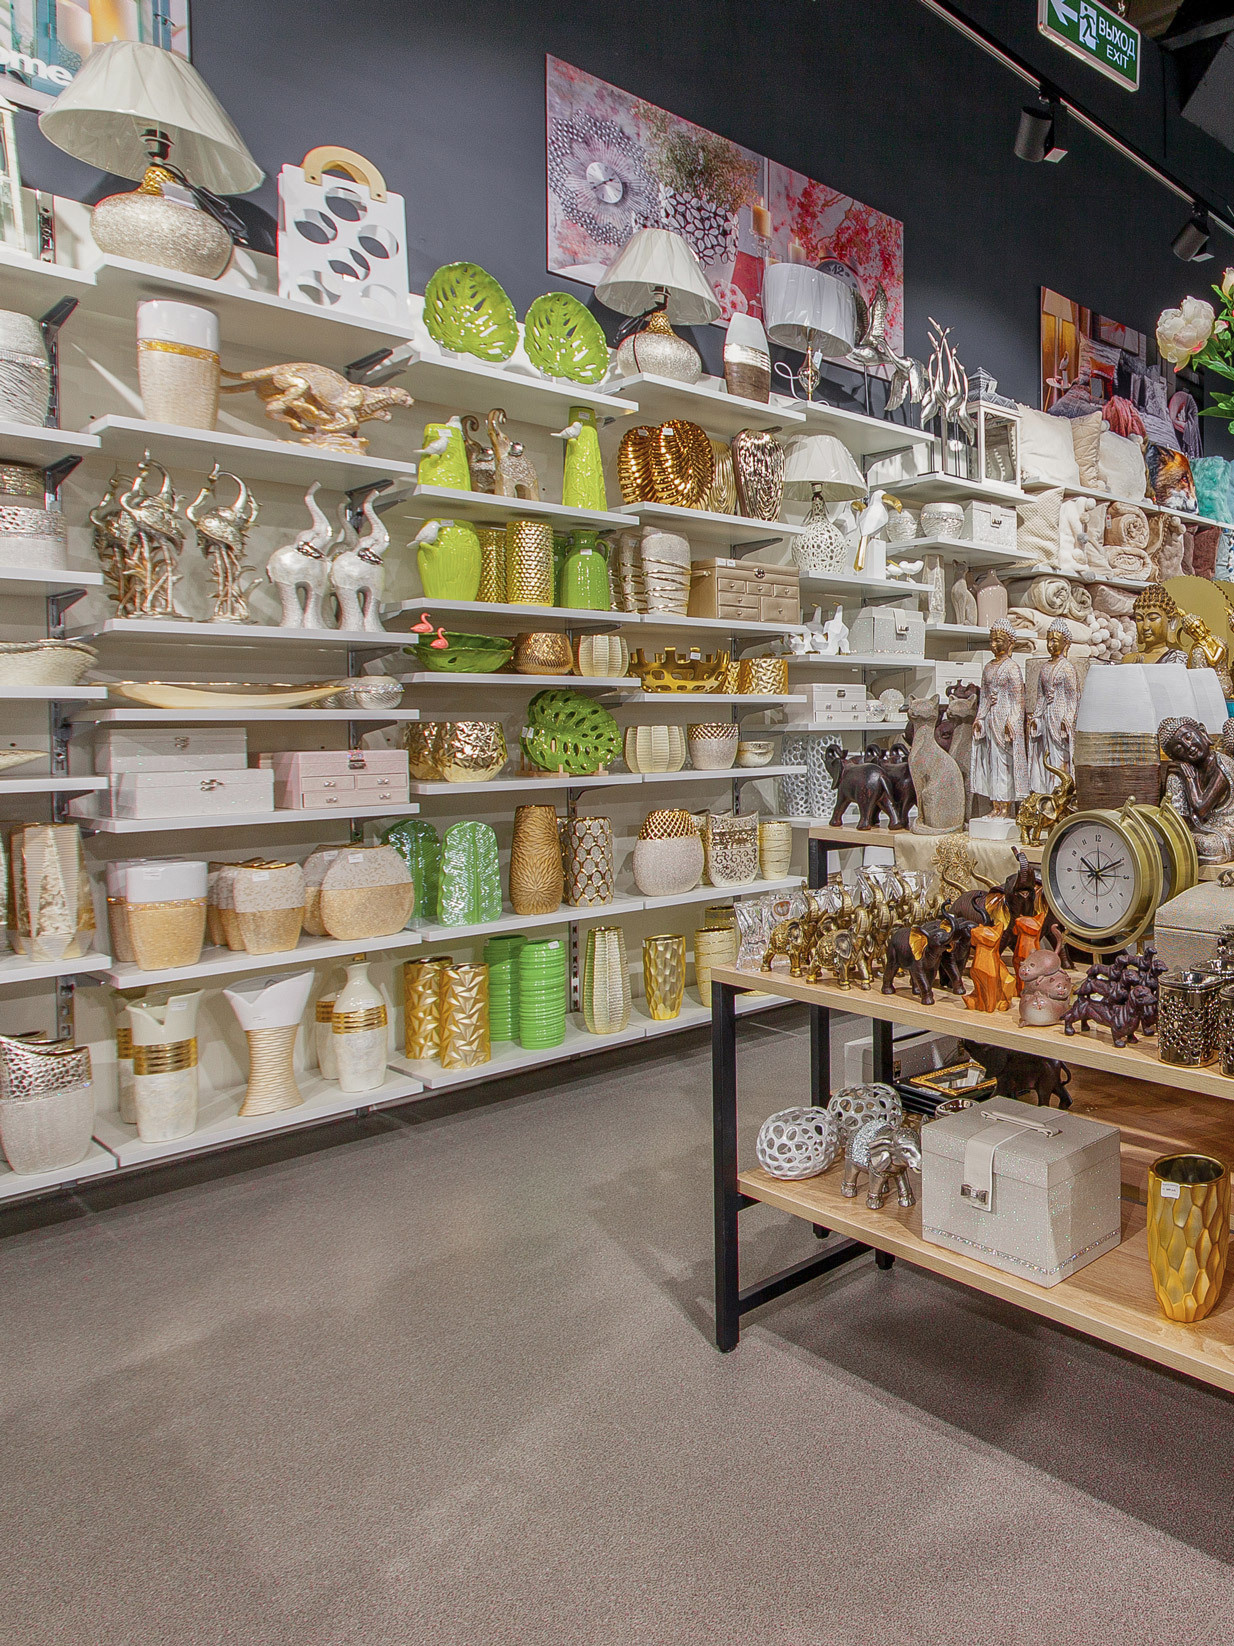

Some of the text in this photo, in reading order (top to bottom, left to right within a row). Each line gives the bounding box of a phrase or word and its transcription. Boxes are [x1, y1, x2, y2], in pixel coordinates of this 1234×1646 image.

[1098, 16, 1135, 60] ВЫХОД
[1106, 44, 1129, 69] EXIT
[831, 264, 844, 277] 12
